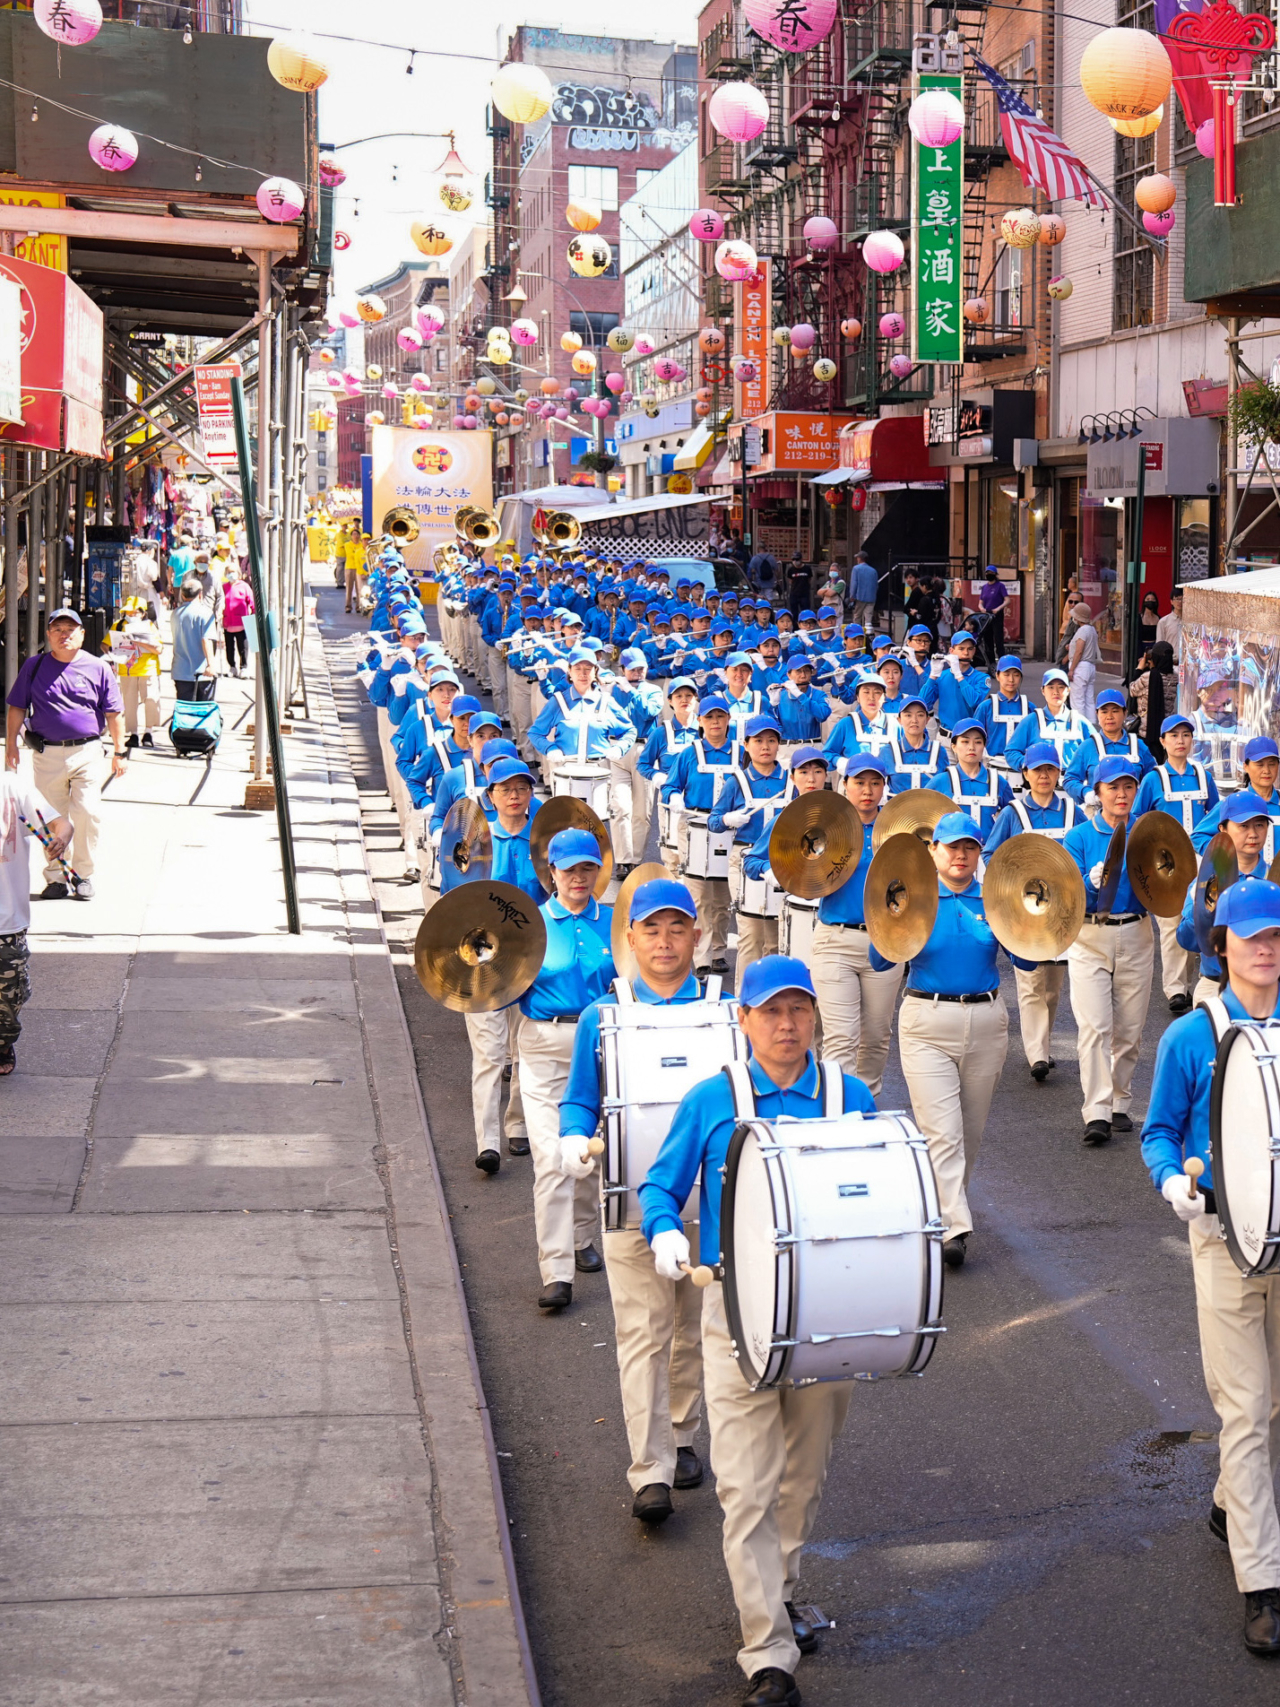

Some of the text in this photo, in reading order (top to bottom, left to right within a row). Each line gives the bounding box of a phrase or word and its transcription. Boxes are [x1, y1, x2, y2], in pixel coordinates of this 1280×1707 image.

[47, 0, 77, 32] 春
[771, 0, 813, 36] 春
[101, 136, 122, 160] 春
[701, 214, 716, 233] 吉
[421, 223, 445, 243] 和
[889, 317, 900, 333] 吉
[706, 333, 720, 347] 和
[197, 369, 234, 379] NO STANDING
[662, 362, 671, 375] 吉
[819, 362, 830, 377] 吉
[200, 390, 231, 400] Except Sunday
[202, 419, 235, 429] NO PARKING
[204, 432, 227, 441] Anytime
[786, 441, 819, 450] CANTON
[396, 486, 471, 499] 法輪大法
[489, 892, 530, 930] Zildjian
